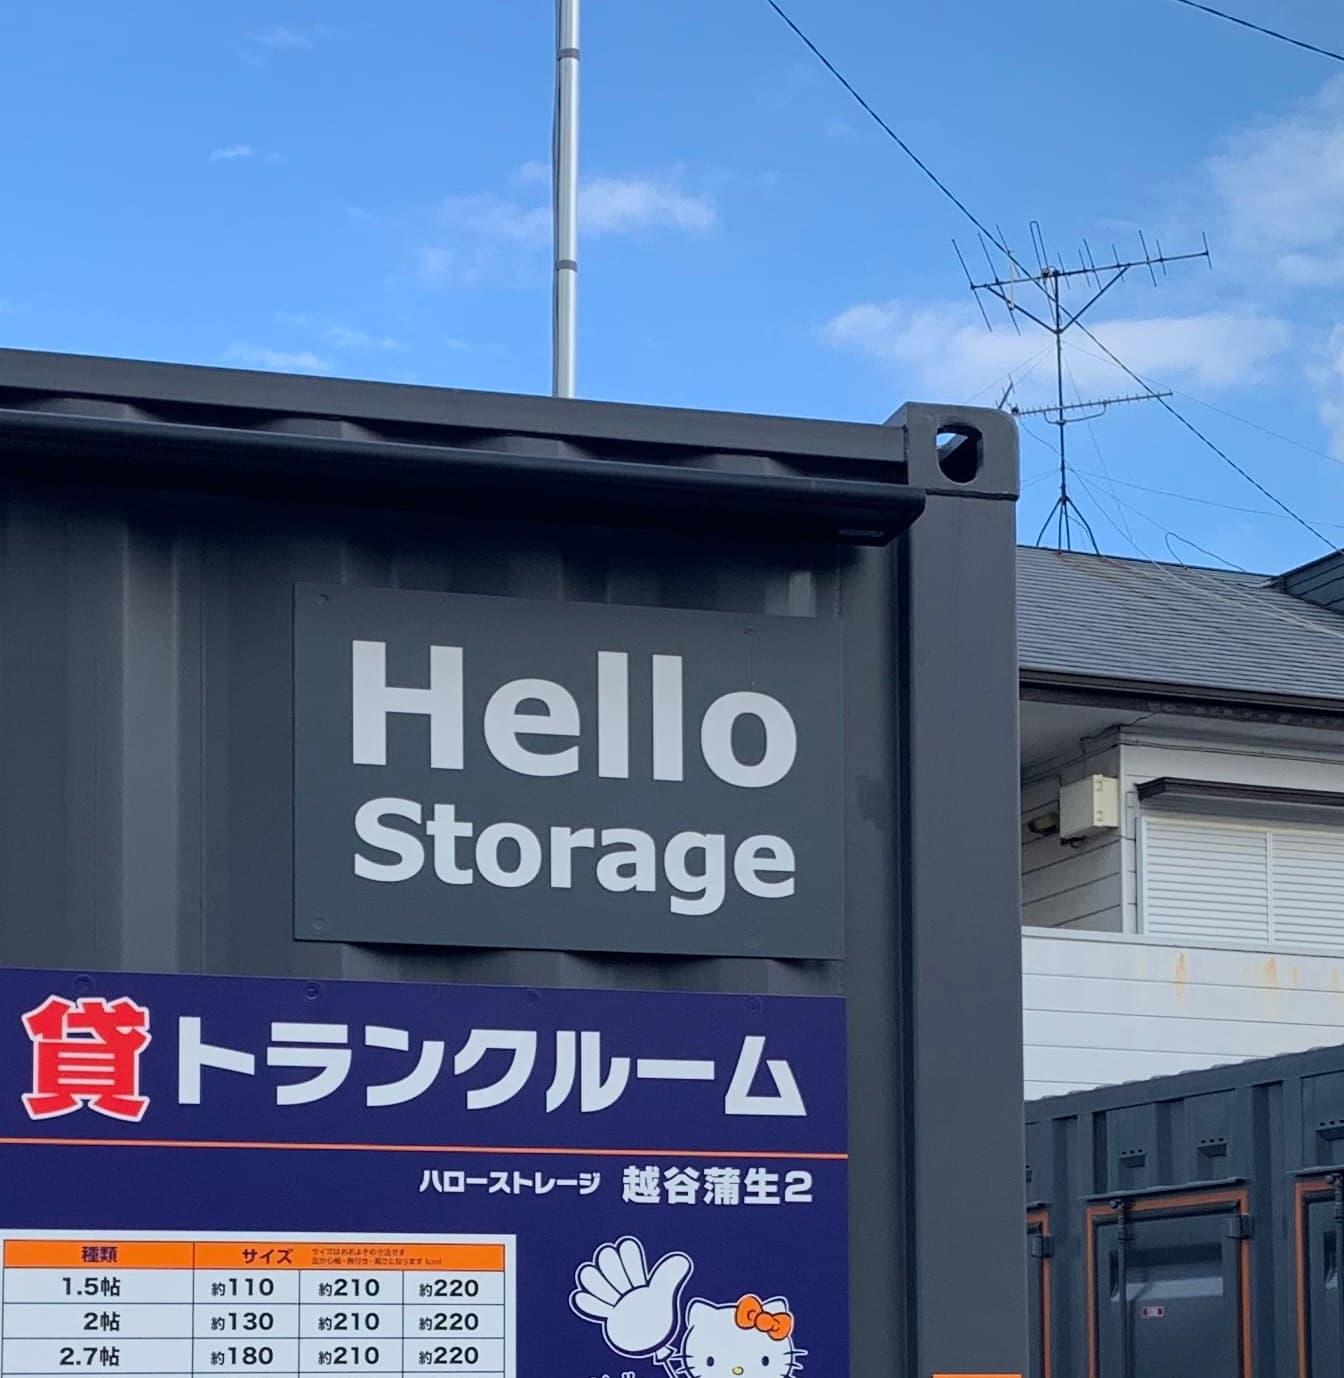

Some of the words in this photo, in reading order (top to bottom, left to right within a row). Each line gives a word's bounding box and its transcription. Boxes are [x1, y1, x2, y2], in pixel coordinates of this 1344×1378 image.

[352, 640, 797, 788] Hello
[354, 797, 796, 915] Storage
[21, 994, 152, 1122] 貸
[178, 1015, 808, 1117] トランクルーム
[419, 1169, 601, 1195] ハローストレージ
[621, 1165, 814, 1205] 越谷蒲生2
[82, 1246, 118, 1263] 種類
[242, 1248, 294, 1265] サイズ
[62, 1276, 121, 1297] 1.5帖
[211, 1277, 275, 1297] 約110
[318, 1278, 380, 1297] 約210
[419, 1279, 479, 1298] 約220
[83, 1311, 120, 1331] 2帖
[211, 1312, 274, 1331] 約130
[318, 1312, 380, 1331] 約210
[419, 1313, 479, 1331] 約220
[59, 1346, 120, 1367] 2.7帖
[210, 1346, 274, 1366] 約180
[318, 1346, 380, 1366] 約210
[419, 1346, 479, 1365] 約220
